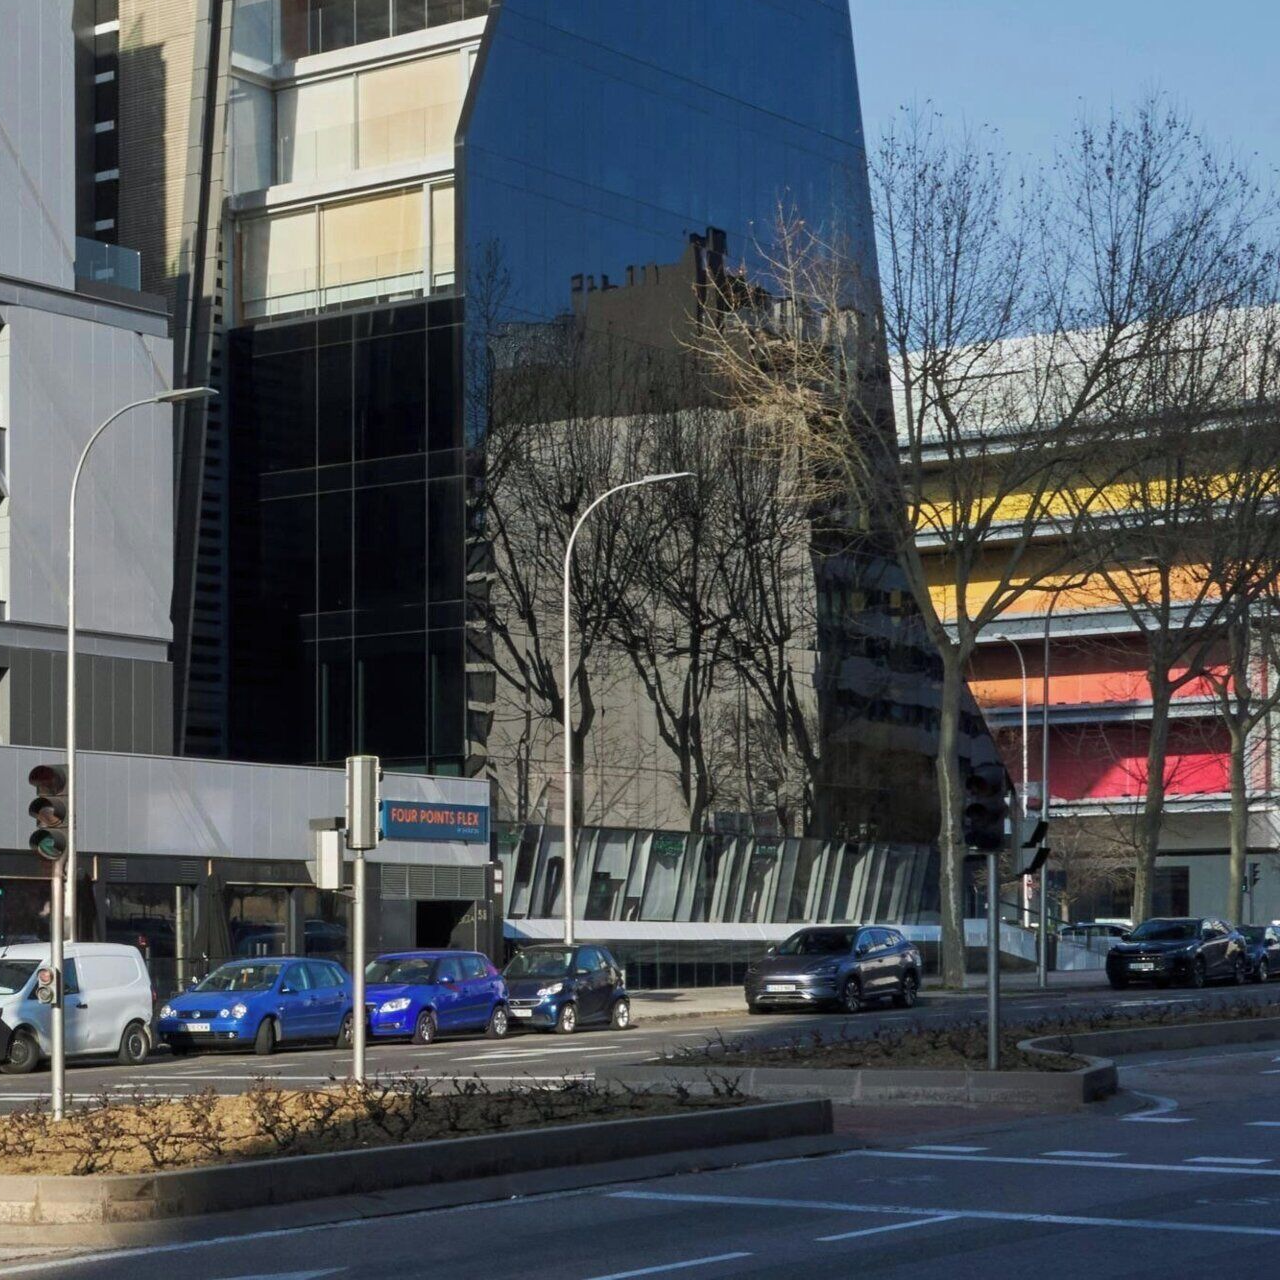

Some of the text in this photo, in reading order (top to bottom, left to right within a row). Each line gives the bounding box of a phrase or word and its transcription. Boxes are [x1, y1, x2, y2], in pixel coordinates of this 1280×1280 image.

[391, 808, 479, 826] FOUR POINTS FLEX
